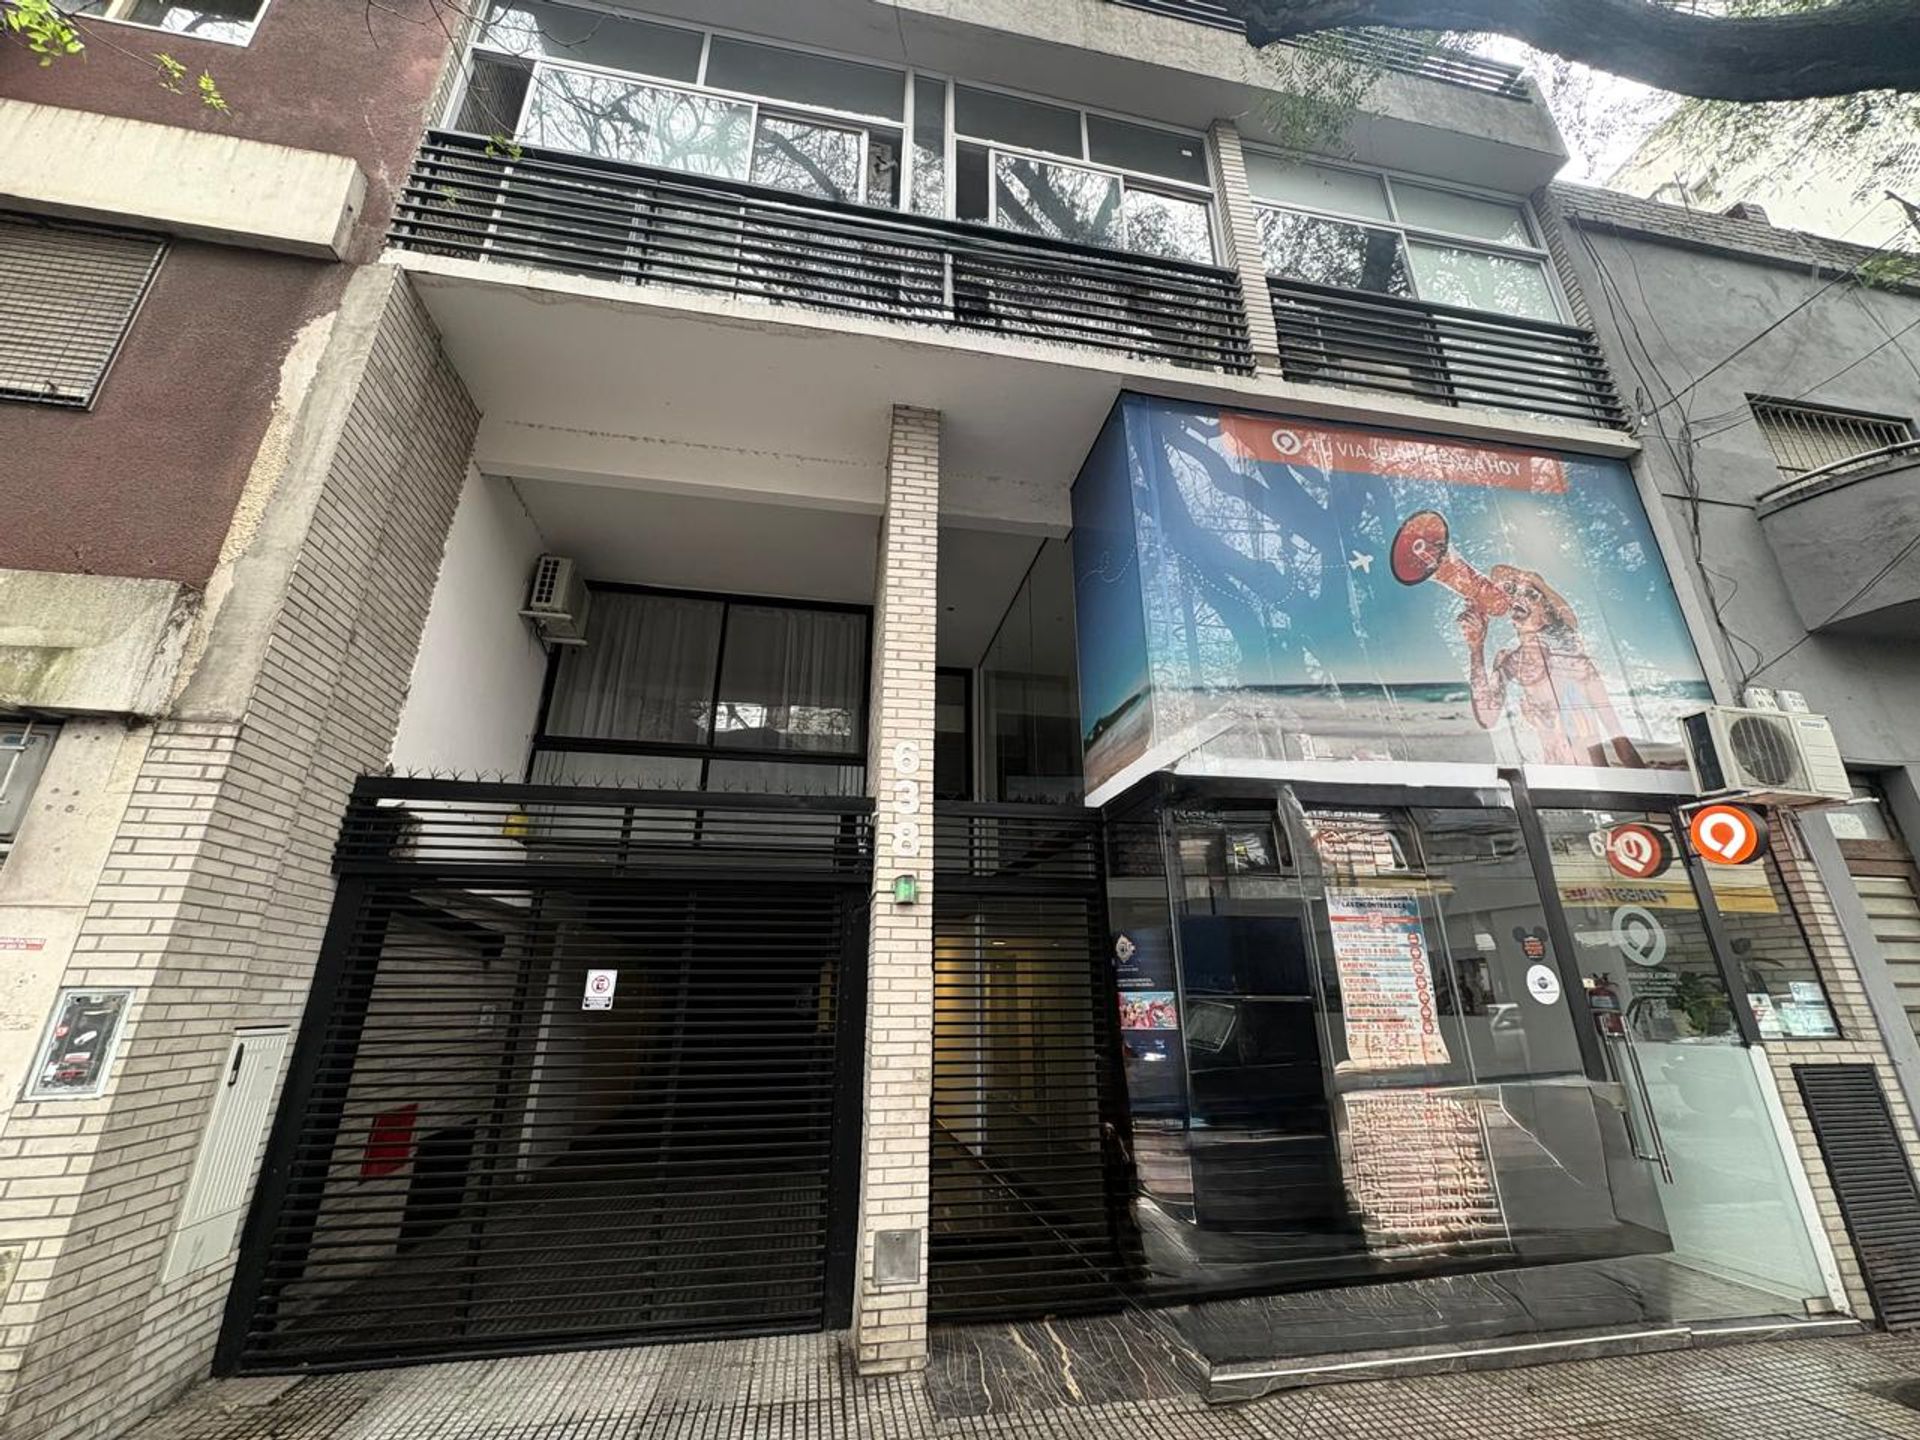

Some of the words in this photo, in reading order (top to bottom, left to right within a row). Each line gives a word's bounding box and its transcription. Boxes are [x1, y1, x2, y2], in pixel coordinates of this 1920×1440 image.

[1336, 442, 1389, 462] VIAJE
[1487, 458, 1522, 477] HOY
[893, 740, 921, 858] 638
